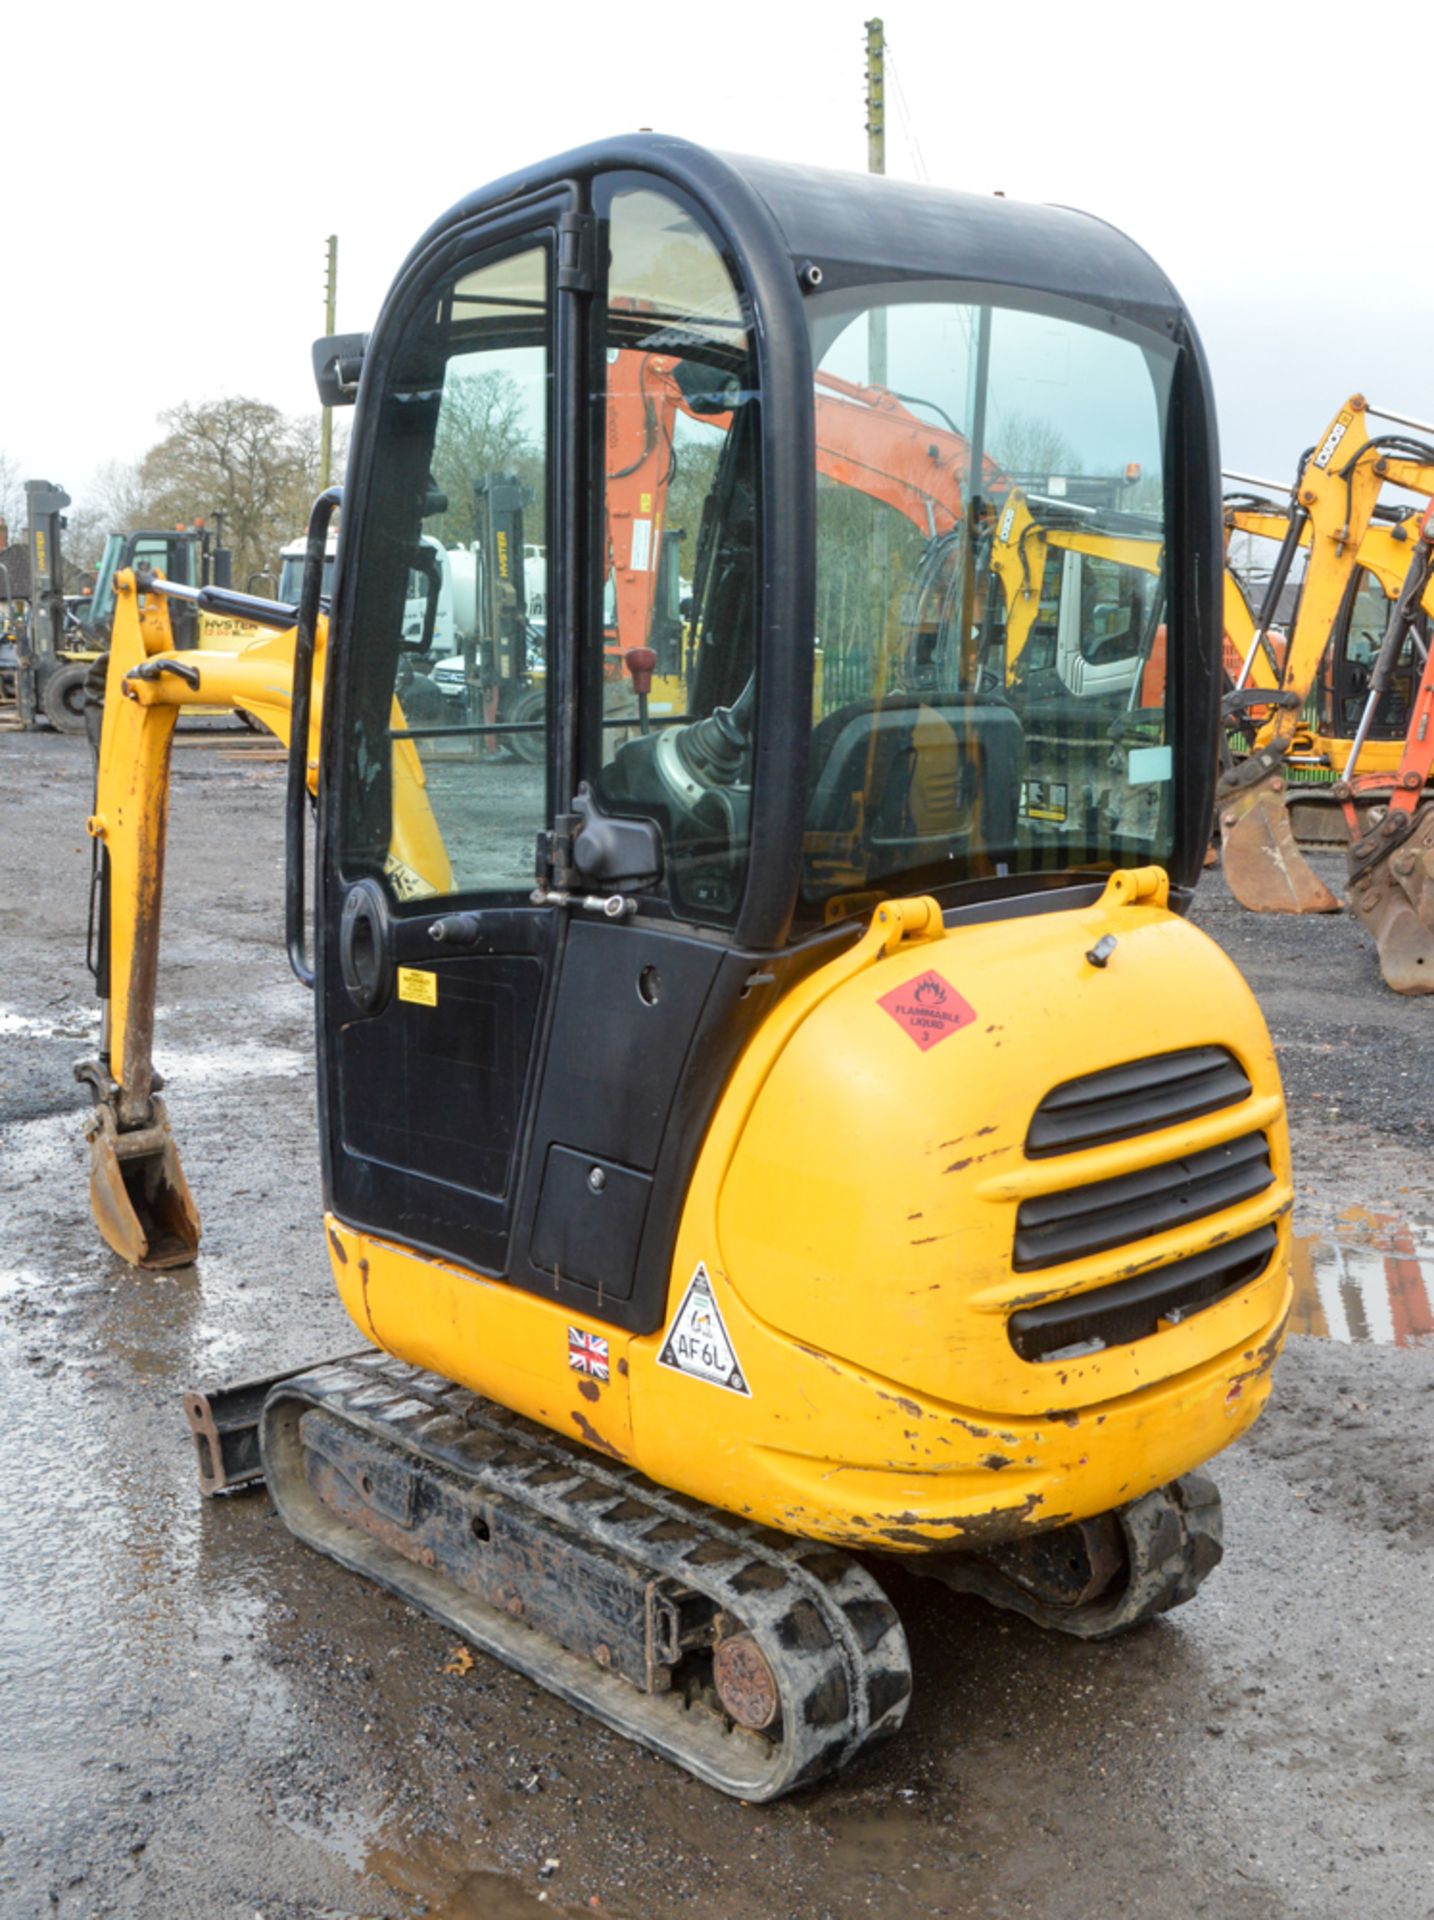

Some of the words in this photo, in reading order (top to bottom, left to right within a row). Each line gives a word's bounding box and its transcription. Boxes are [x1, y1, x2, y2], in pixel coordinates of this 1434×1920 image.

[496, 531, 509, 577] HYSTER
[895, 1005, 961, 1024] FLAMMABLE
[910, 1017, 945, 1030] LIQUID
[921, 1031, 930, 1042] 3
